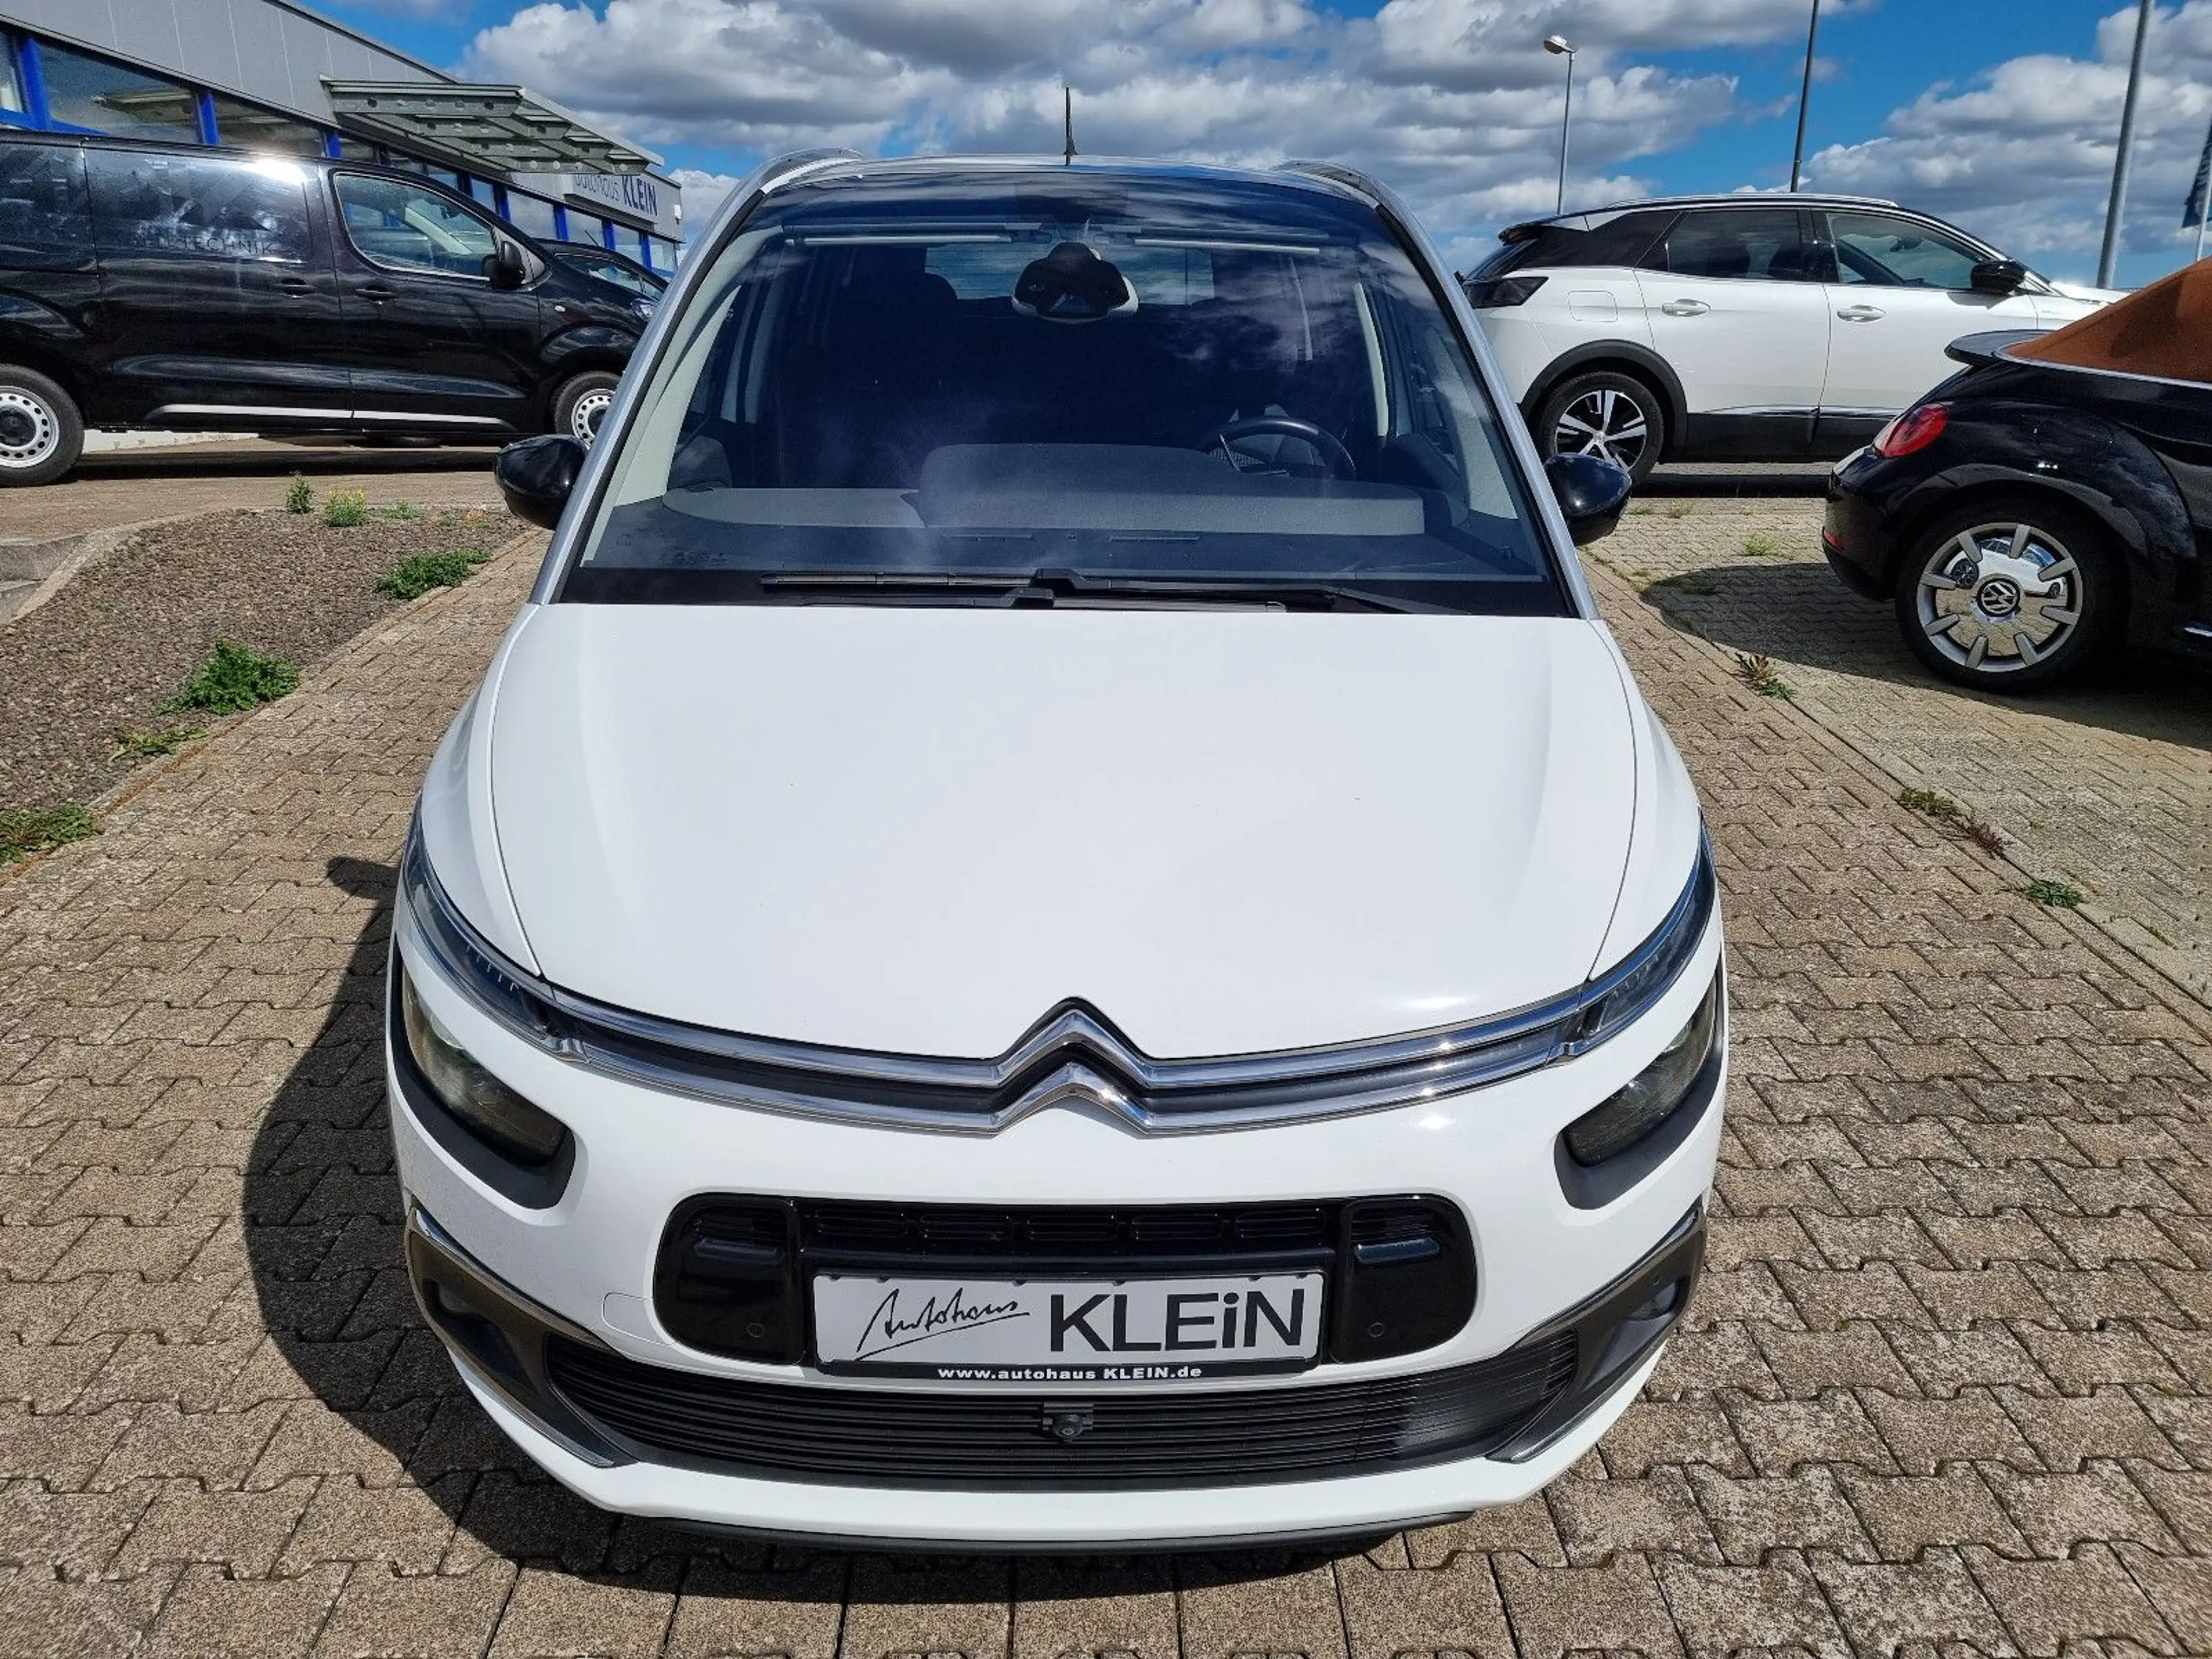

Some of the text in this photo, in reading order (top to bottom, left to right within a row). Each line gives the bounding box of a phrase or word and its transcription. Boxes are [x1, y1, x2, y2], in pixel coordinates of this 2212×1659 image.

[622, 175, 658, 217] KLEIN
[856, 1287, 1018, 1353] Autohaus
[937, 1366, 1203, 1380] www.autohaus KLEIN.de
